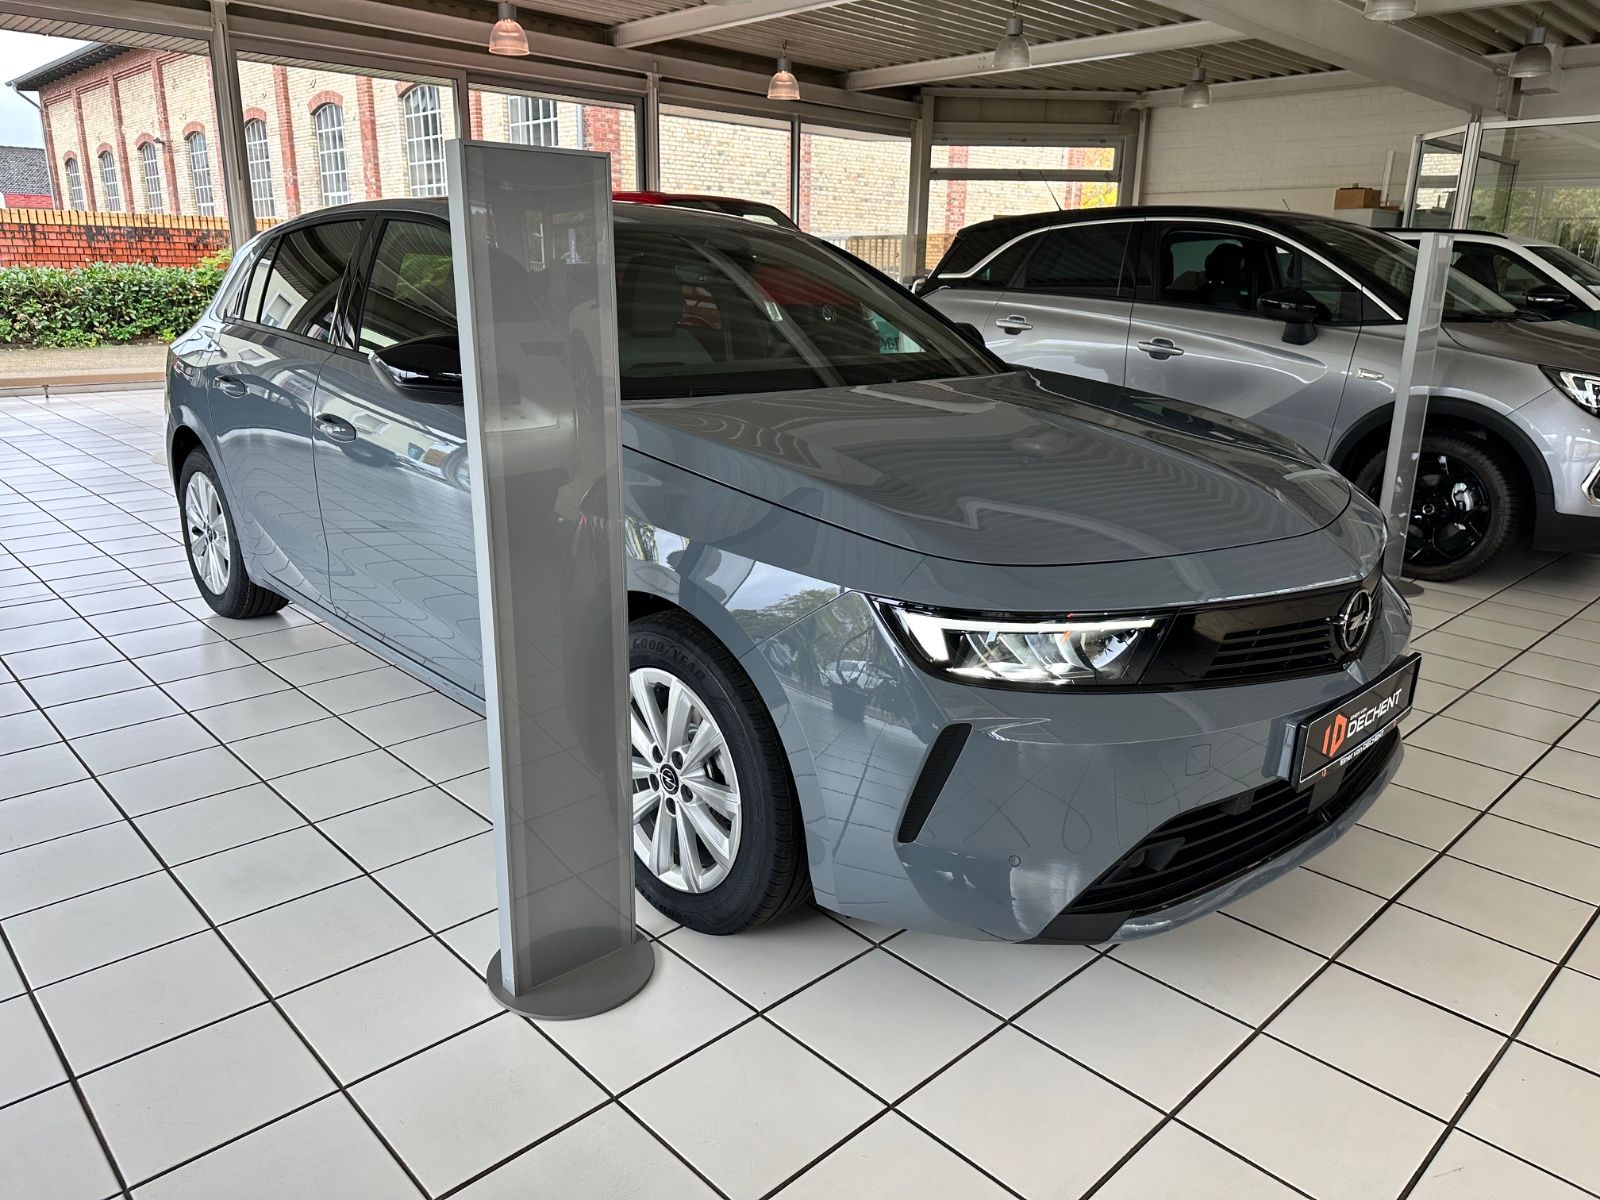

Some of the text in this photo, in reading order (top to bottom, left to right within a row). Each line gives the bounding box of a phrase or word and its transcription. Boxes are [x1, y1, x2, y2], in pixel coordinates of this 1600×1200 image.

[1347, 688, 1402, 738] DECHENT
[1339, 729, 1385, 766] Einer von DECHENT
